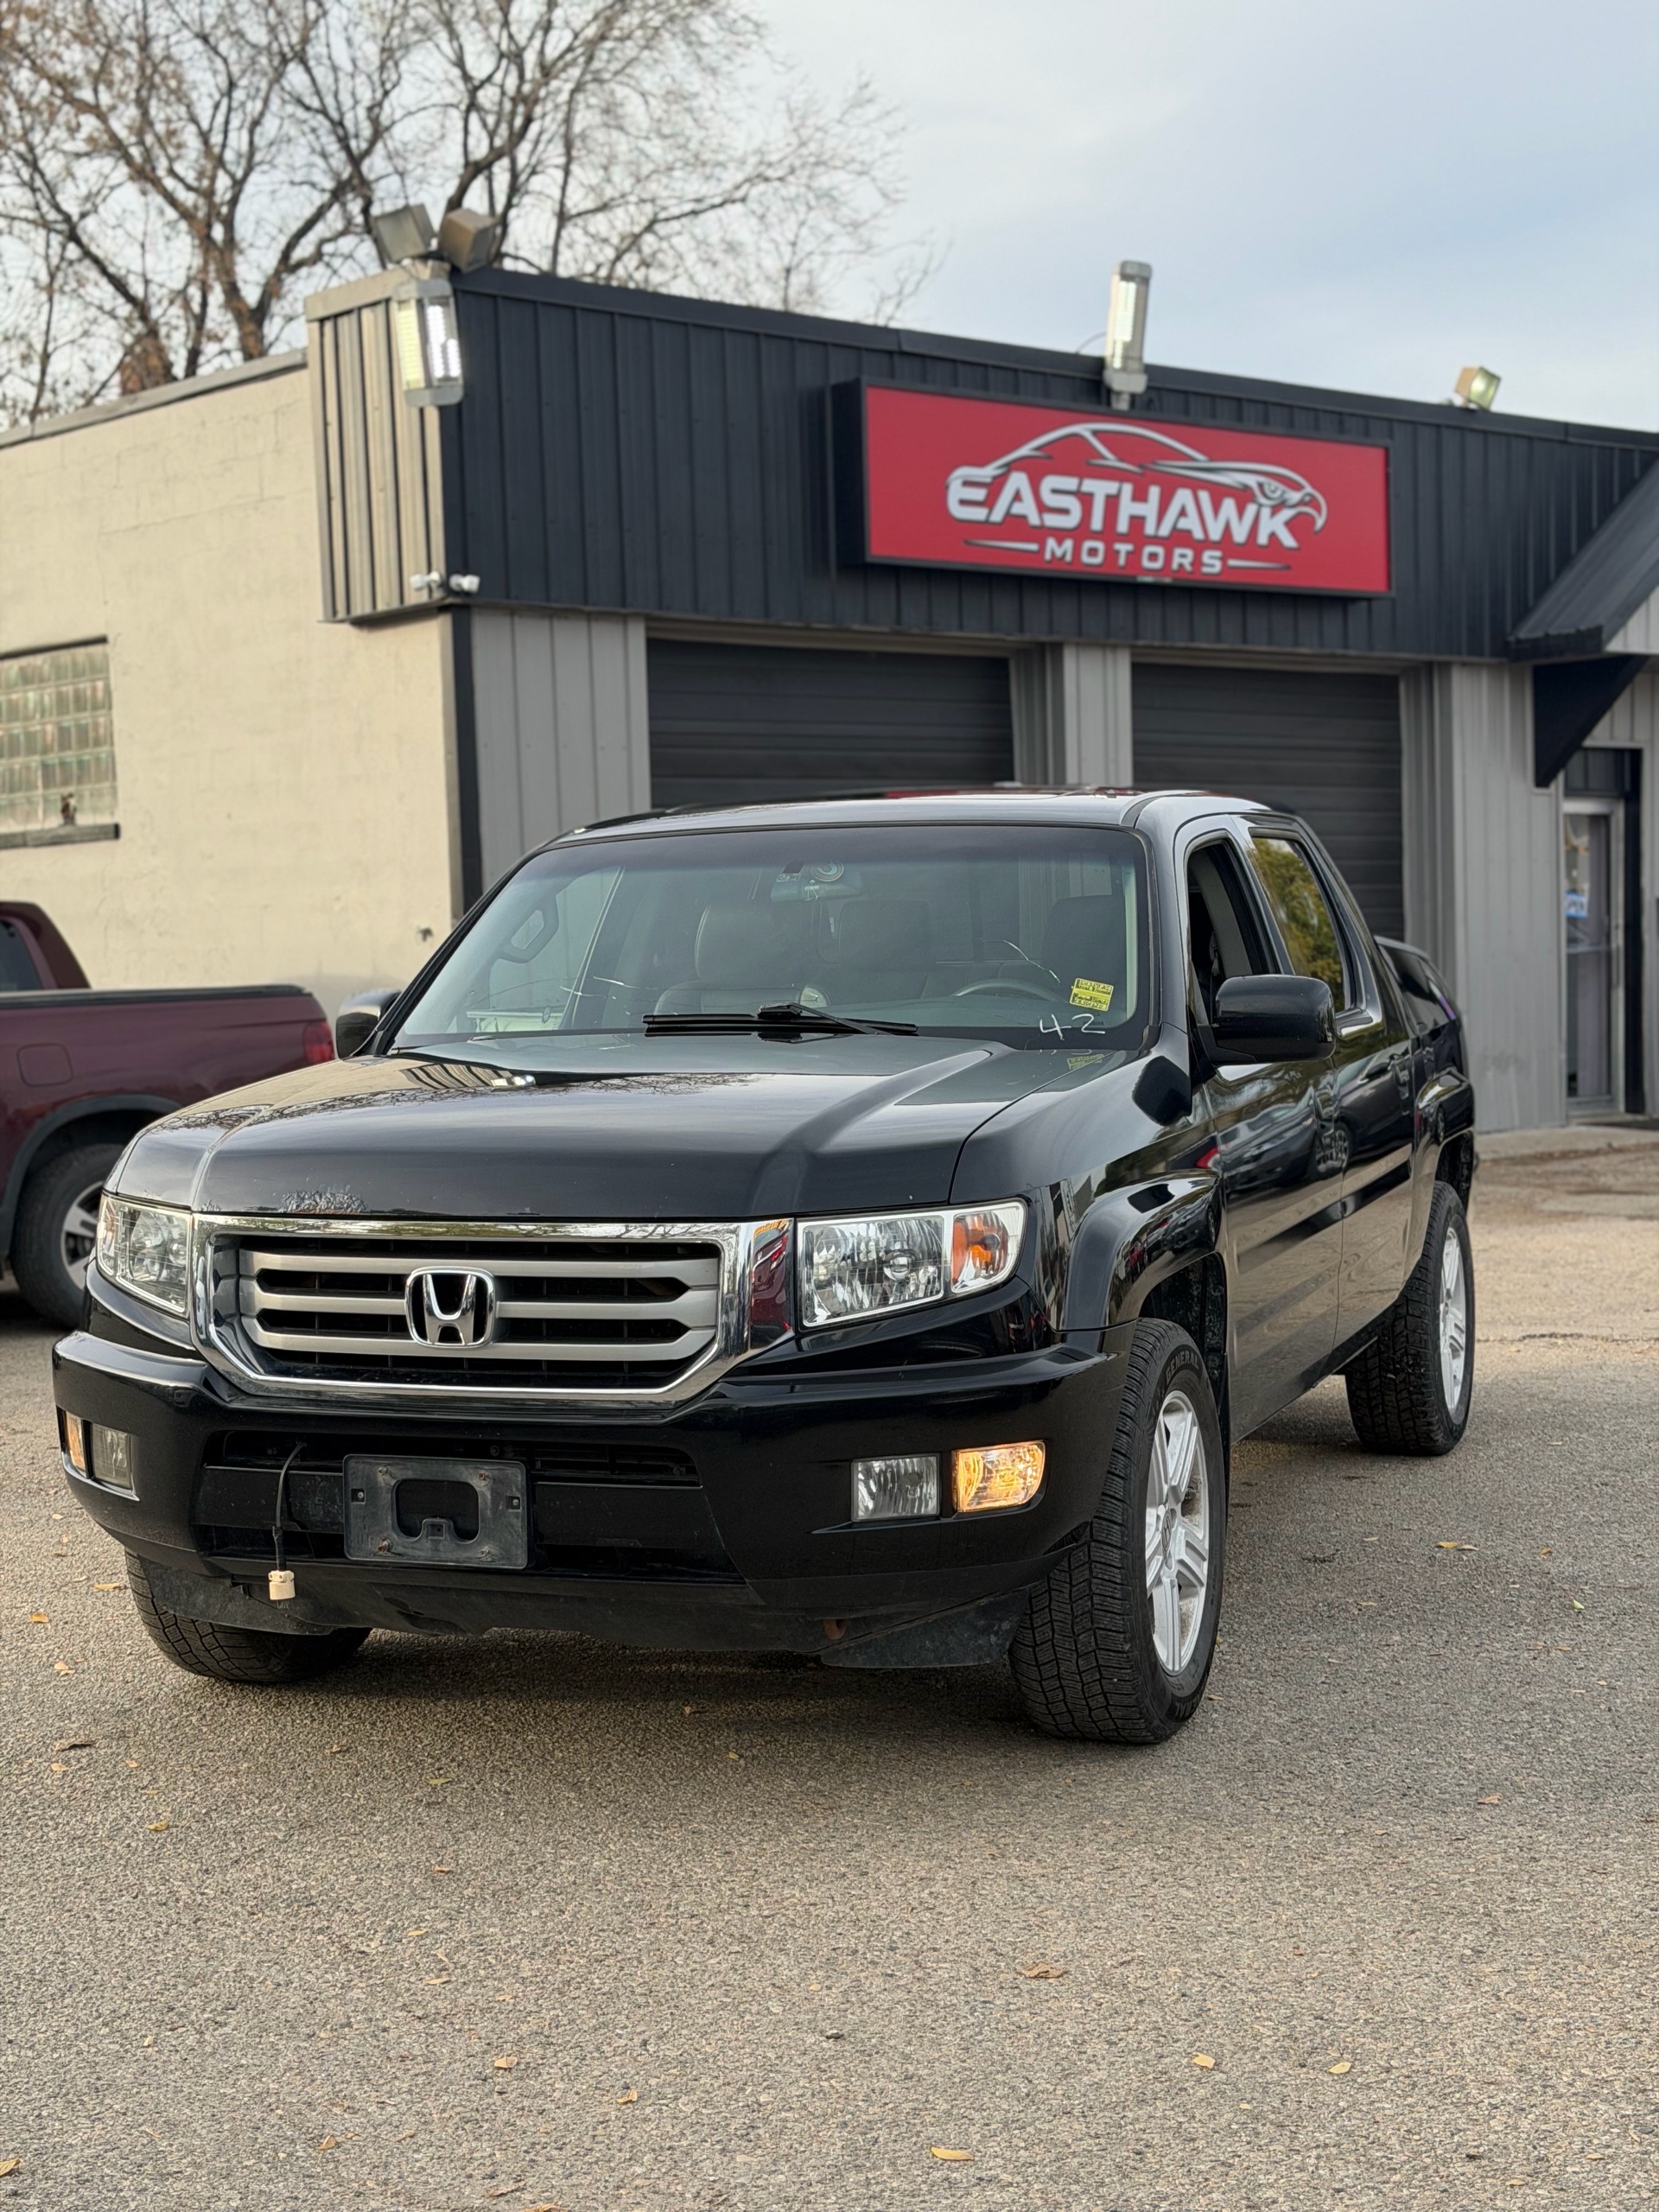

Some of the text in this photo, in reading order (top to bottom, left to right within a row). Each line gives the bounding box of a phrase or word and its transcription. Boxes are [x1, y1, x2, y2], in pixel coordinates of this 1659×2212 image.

[947, 467, 1300, 550] EASTHAWK
[1044, 537, 1224, 575] MOTORS
[1166, 1350, 1199, 1385] GENERAL
